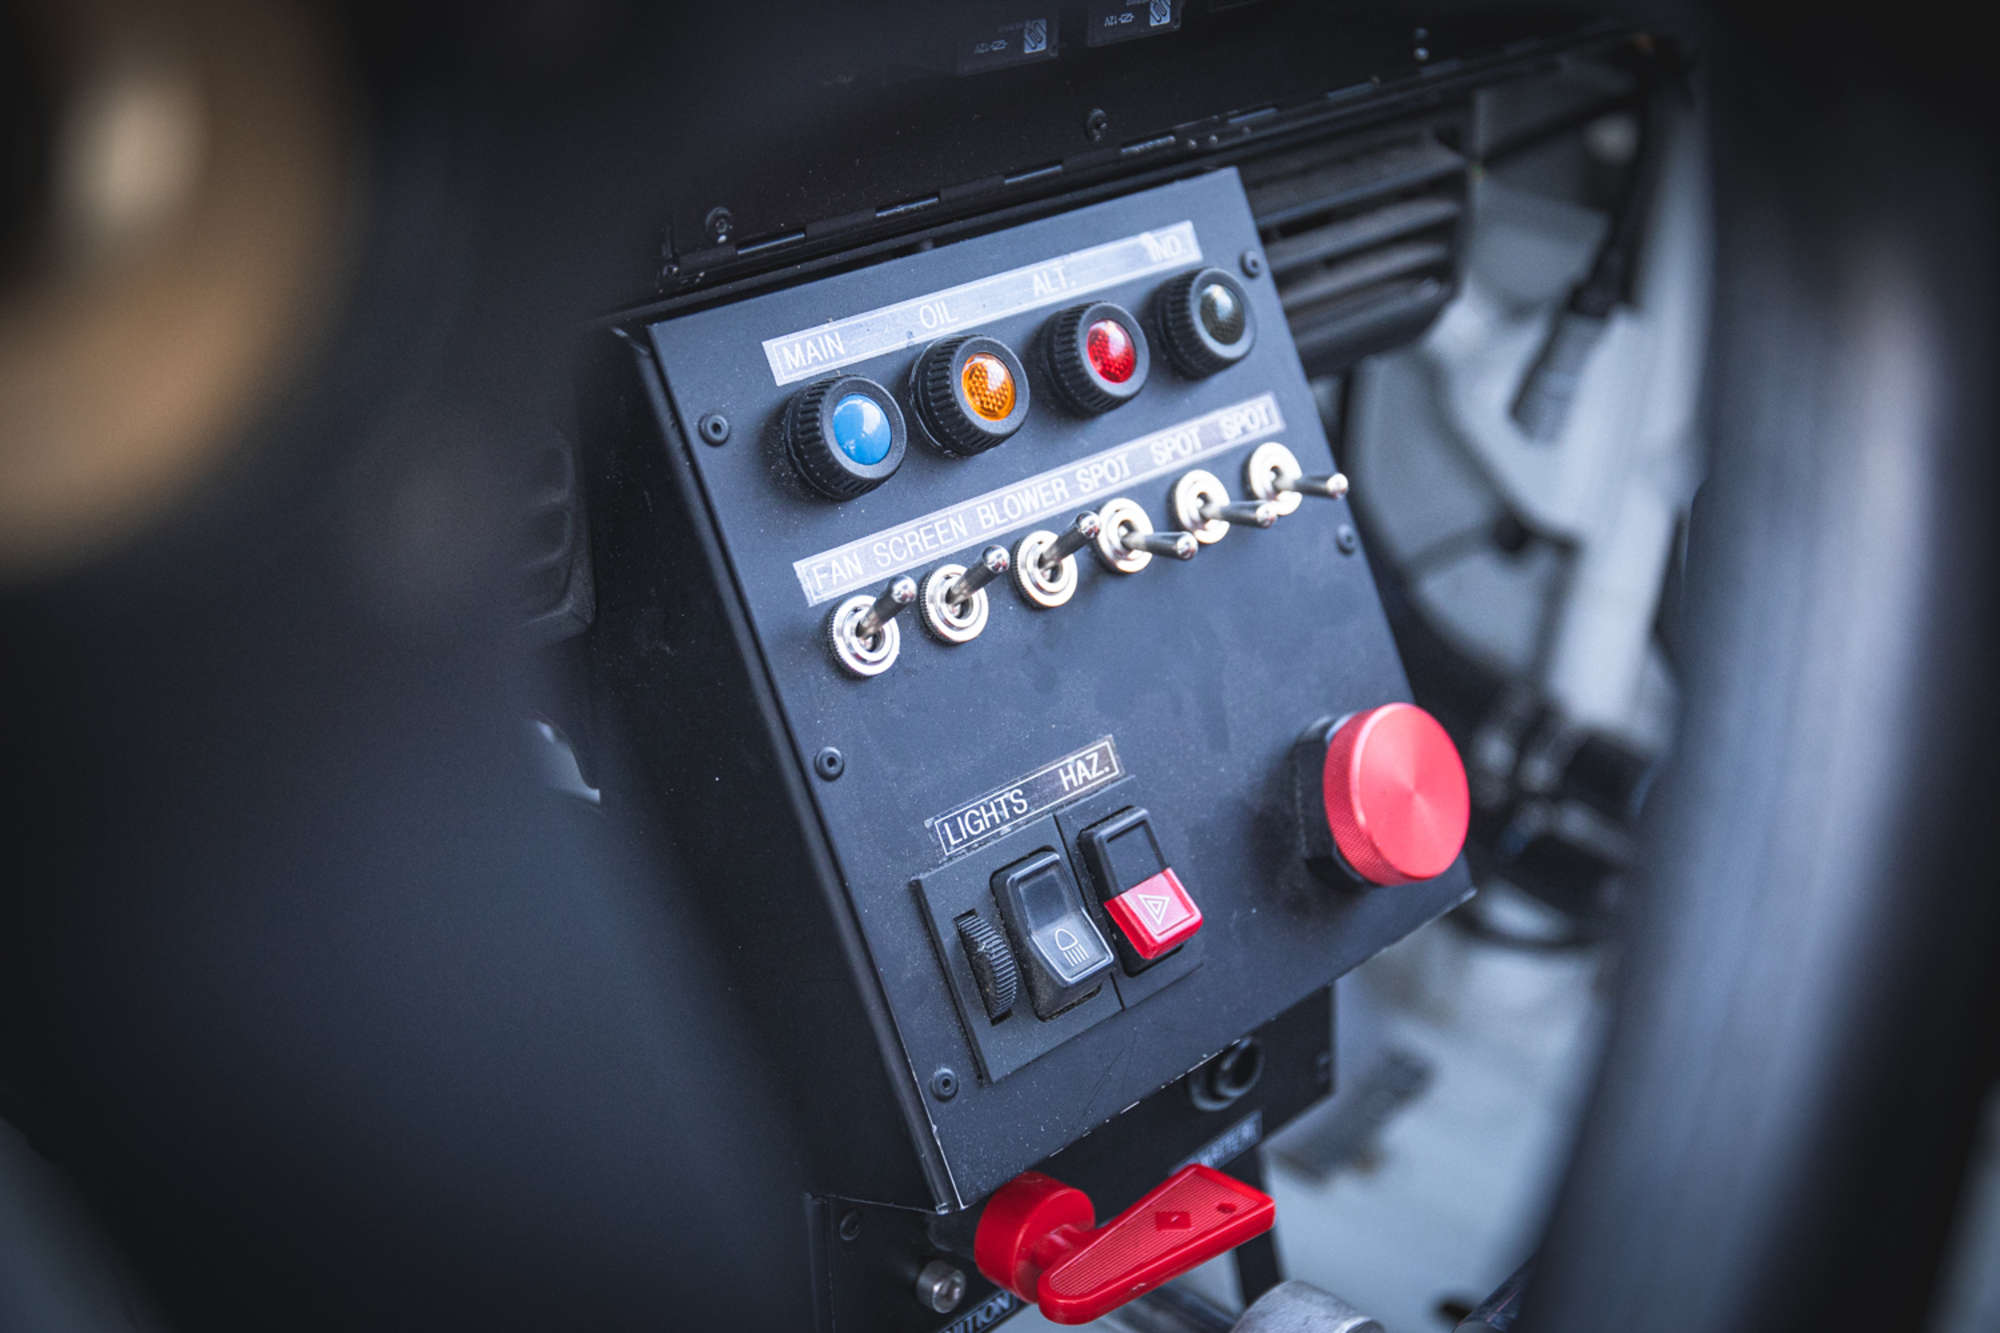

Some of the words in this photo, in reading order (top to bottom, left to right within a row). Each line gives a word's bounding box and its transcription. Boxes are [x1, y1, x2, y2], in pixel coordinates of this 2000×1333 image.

[783, 334, 845, 370] MAIN
[919, 303, 958, 329] OIL
[1032, 266, 1075, 296] ALT.
[811, 551, 862, 591] FAN
[872, 515, 968, 564] SCREEN
[976, 482, 1070, 529] BLOWER
[1076, 456, 1132, 494] SPOT
[1150, 429, 1205, 465] SPOT
[1220, 404, 1273, 440] SPOT
[943, 788, 1028, 845] LIGHTS
[1058, 751, 1109, 791] HAZ.
